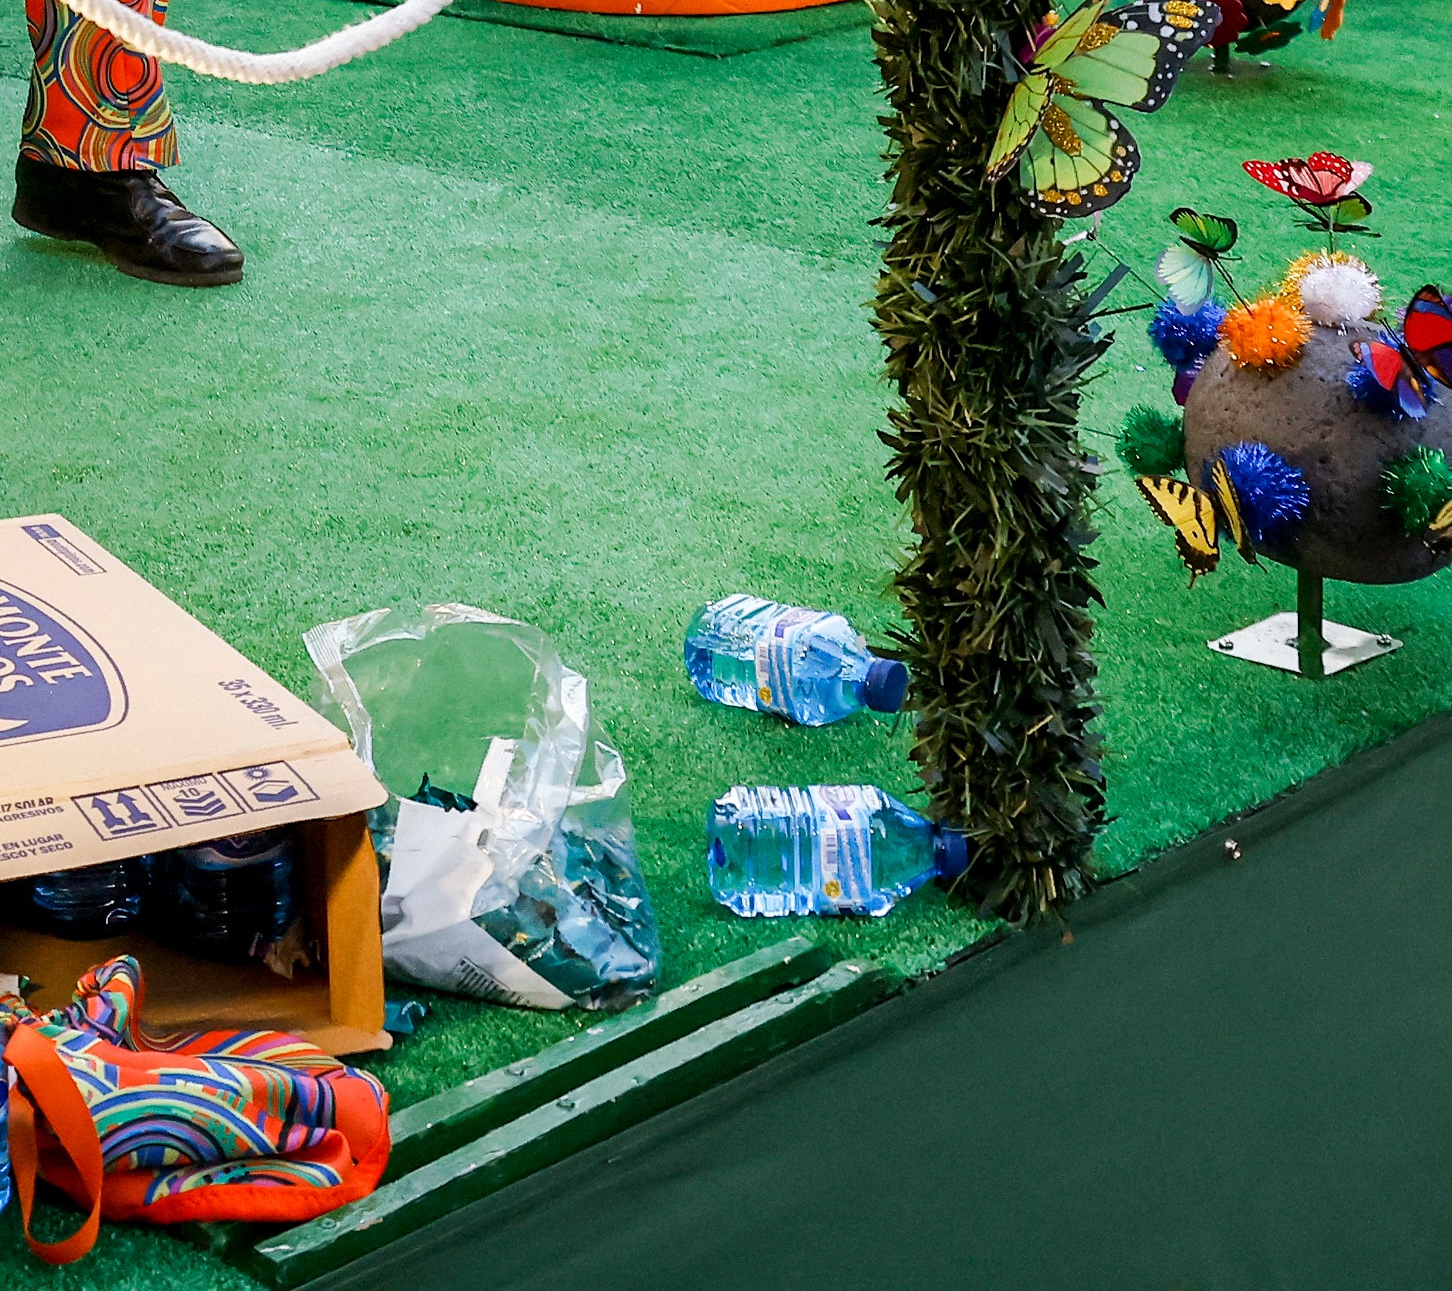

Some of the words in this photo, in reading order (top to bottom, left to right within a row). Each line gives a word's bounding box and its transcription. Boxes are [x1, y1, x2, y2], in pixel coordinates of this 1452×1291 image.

[240, 697, 281, 714] 330
[178, 787, 201, 798] 10
[2, 842, 20, 851] EN
[21, 834, 65, 847] LUGAR
[27, 849, 38, 857] Y
[39, 841, 74, 854] SECO
